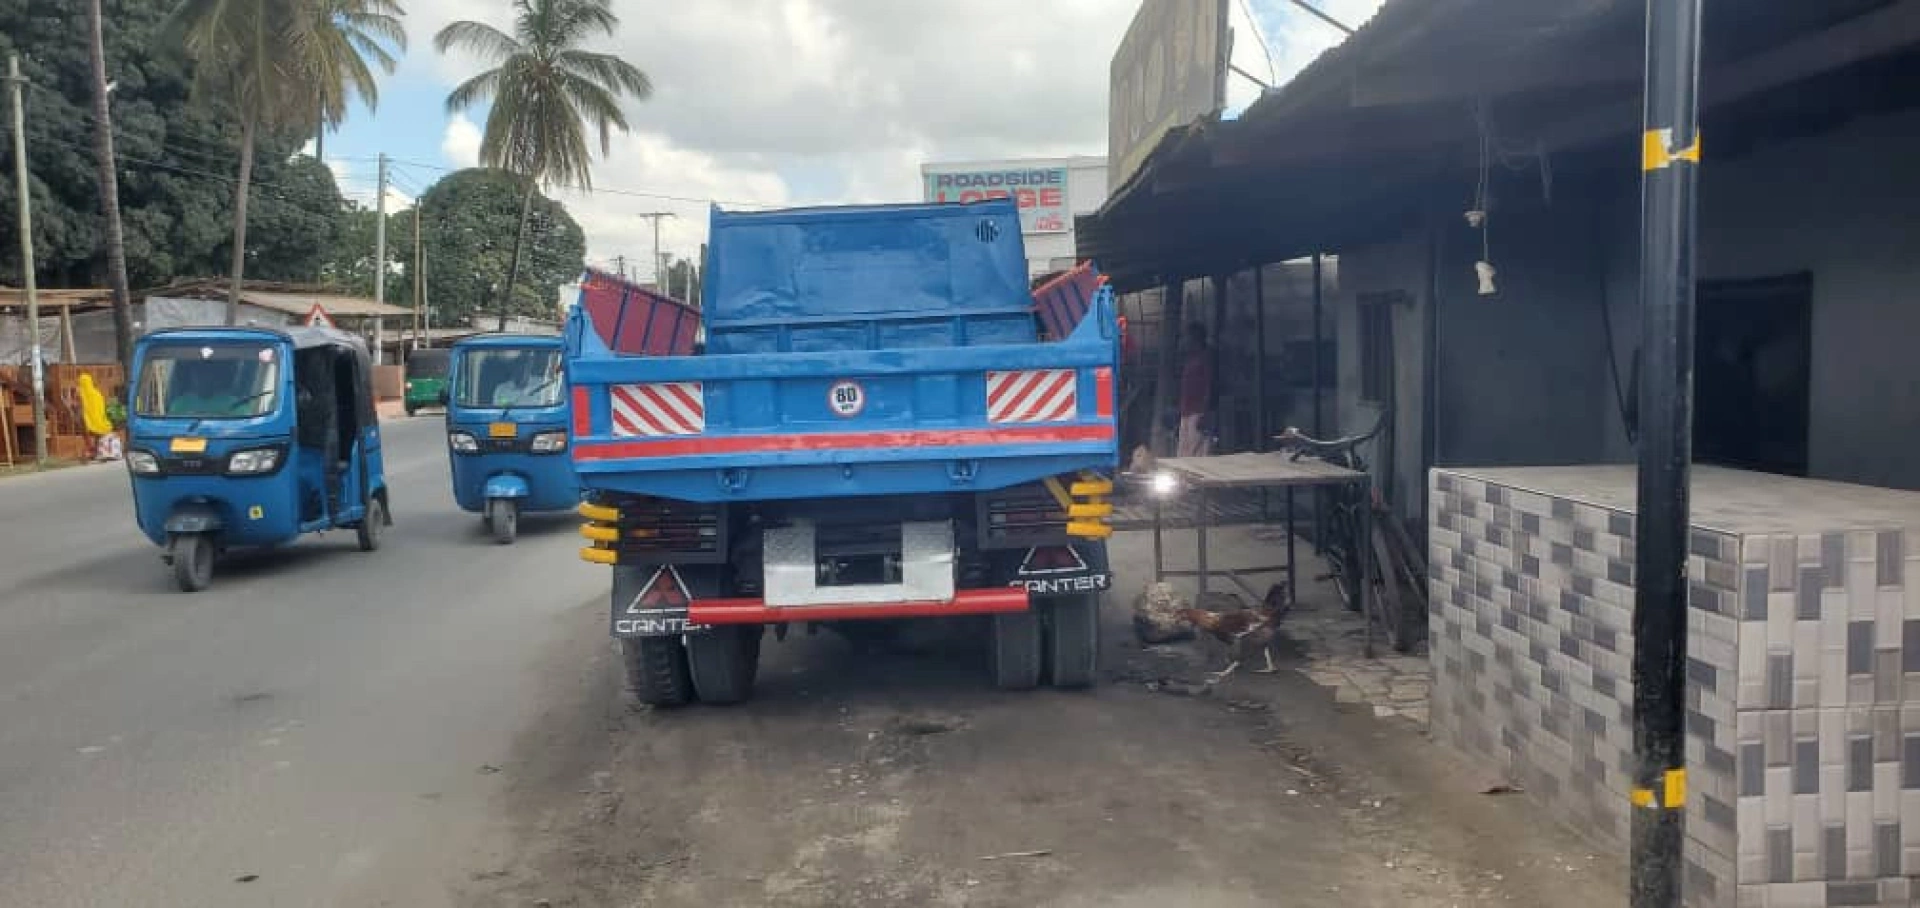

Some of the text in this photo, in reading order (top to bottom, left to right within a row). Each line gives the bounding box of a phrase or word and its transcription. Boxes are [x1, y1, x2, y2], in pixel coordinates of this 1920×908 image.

[937, 167, 1061, 187] ROADSIDE
[836, 386, 857, 402] 80
[616, 618, 711, 633] CANTE
